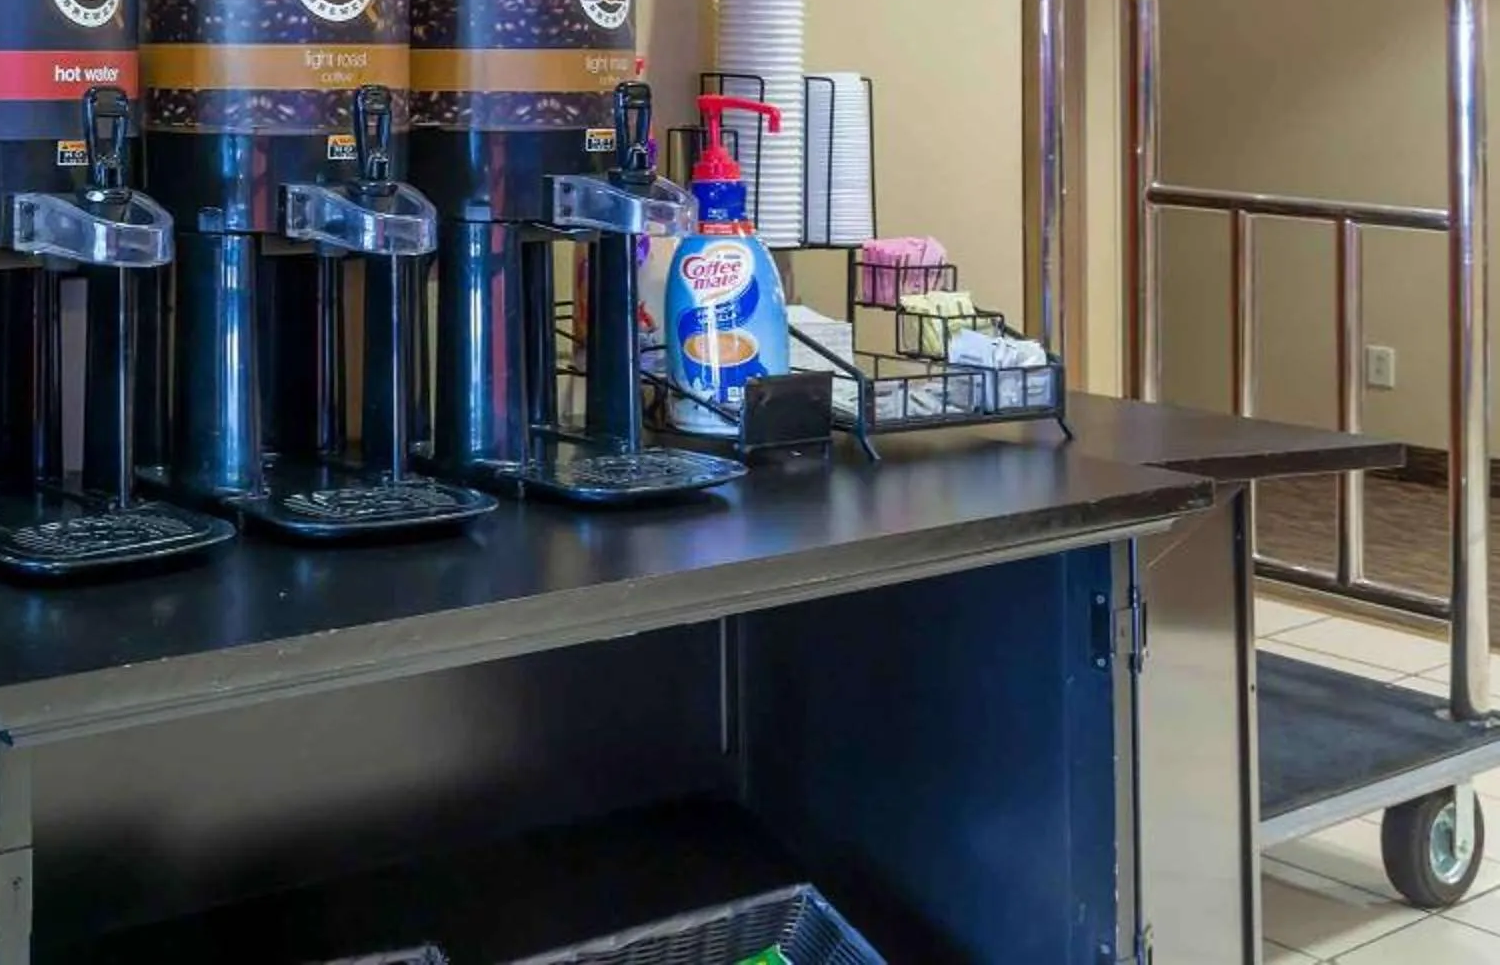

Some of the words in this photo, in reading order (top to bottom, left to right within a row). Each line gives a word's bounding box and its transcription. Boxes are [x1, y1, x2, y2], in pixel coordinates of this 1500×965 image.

[54, 65, 81, 82] hot
[84, 67, 120, 82] water
[683, 254, 742, 280] Coffee
[693, 273, 739, 290] mate
